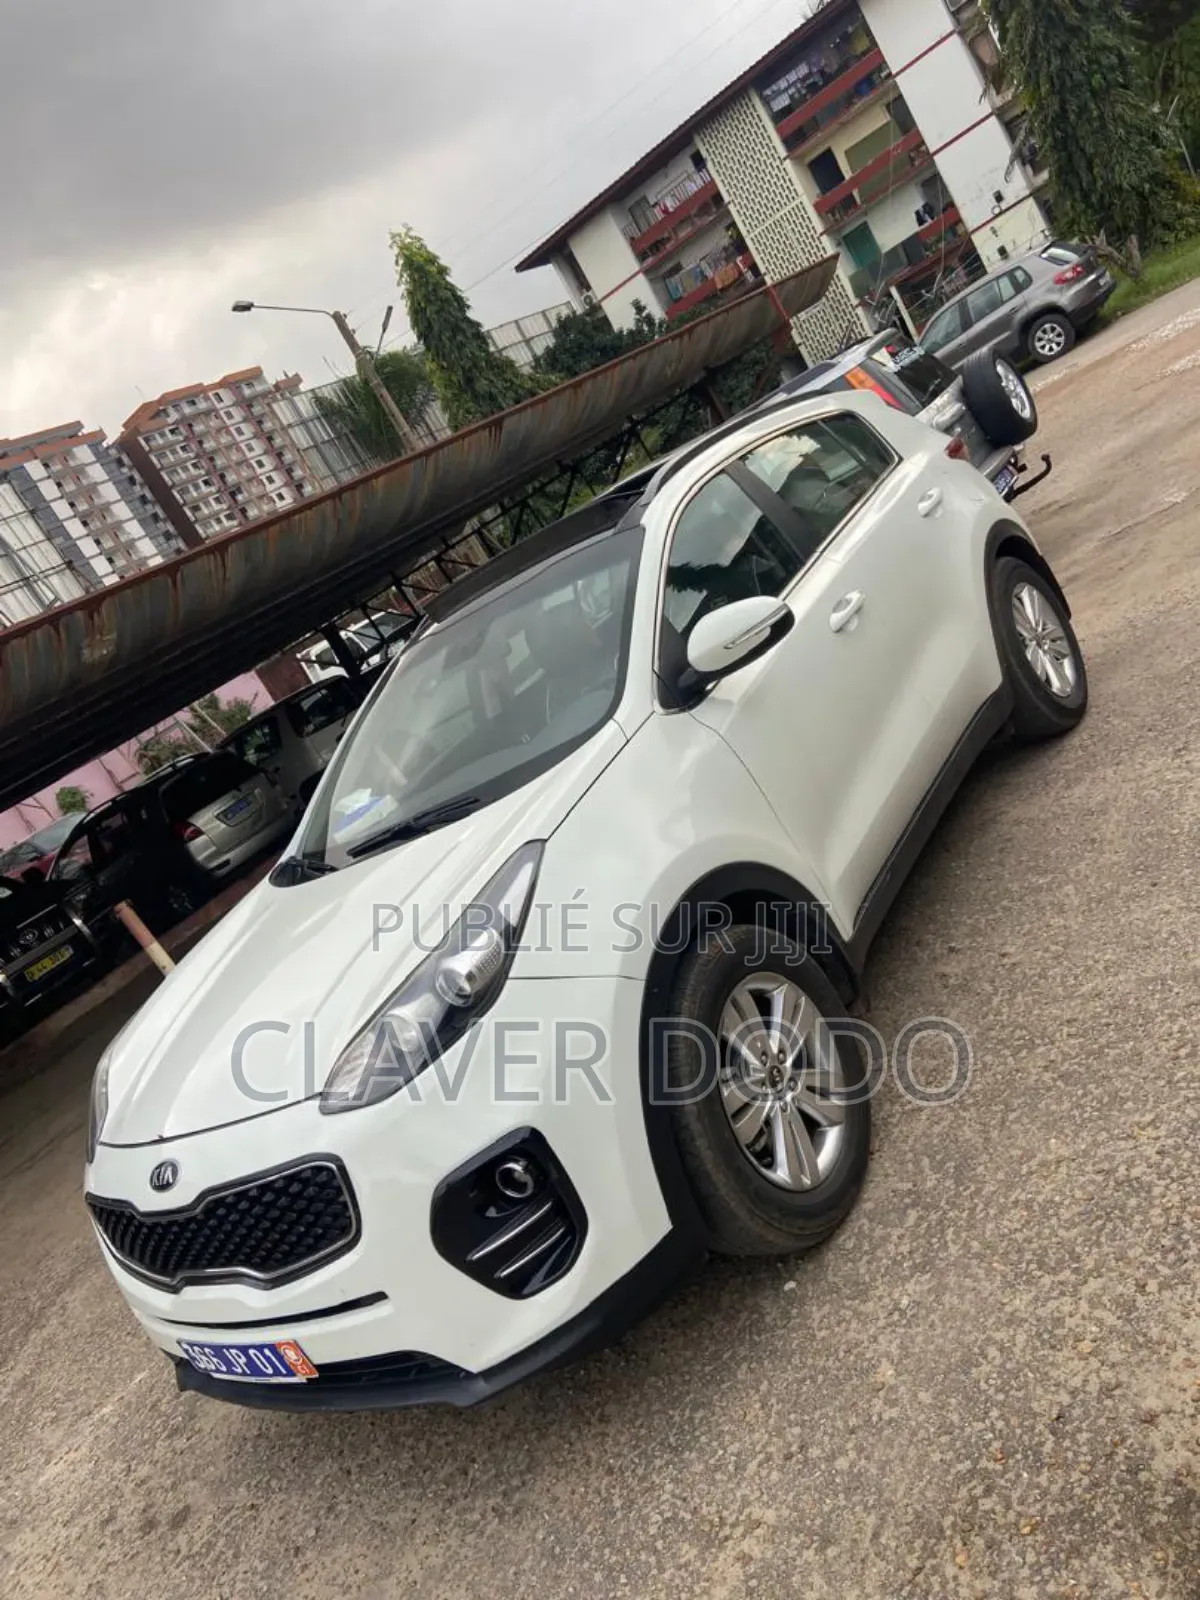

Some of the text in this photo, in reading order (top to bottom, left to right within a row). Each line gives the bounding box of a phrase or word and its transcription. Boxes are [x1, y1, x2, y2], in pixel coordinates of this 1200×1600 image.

[152, 1166, 173, 1186] KIA
[223, 1348, 250, 1374] JP
[248, 1348, 287, 1374] 01
